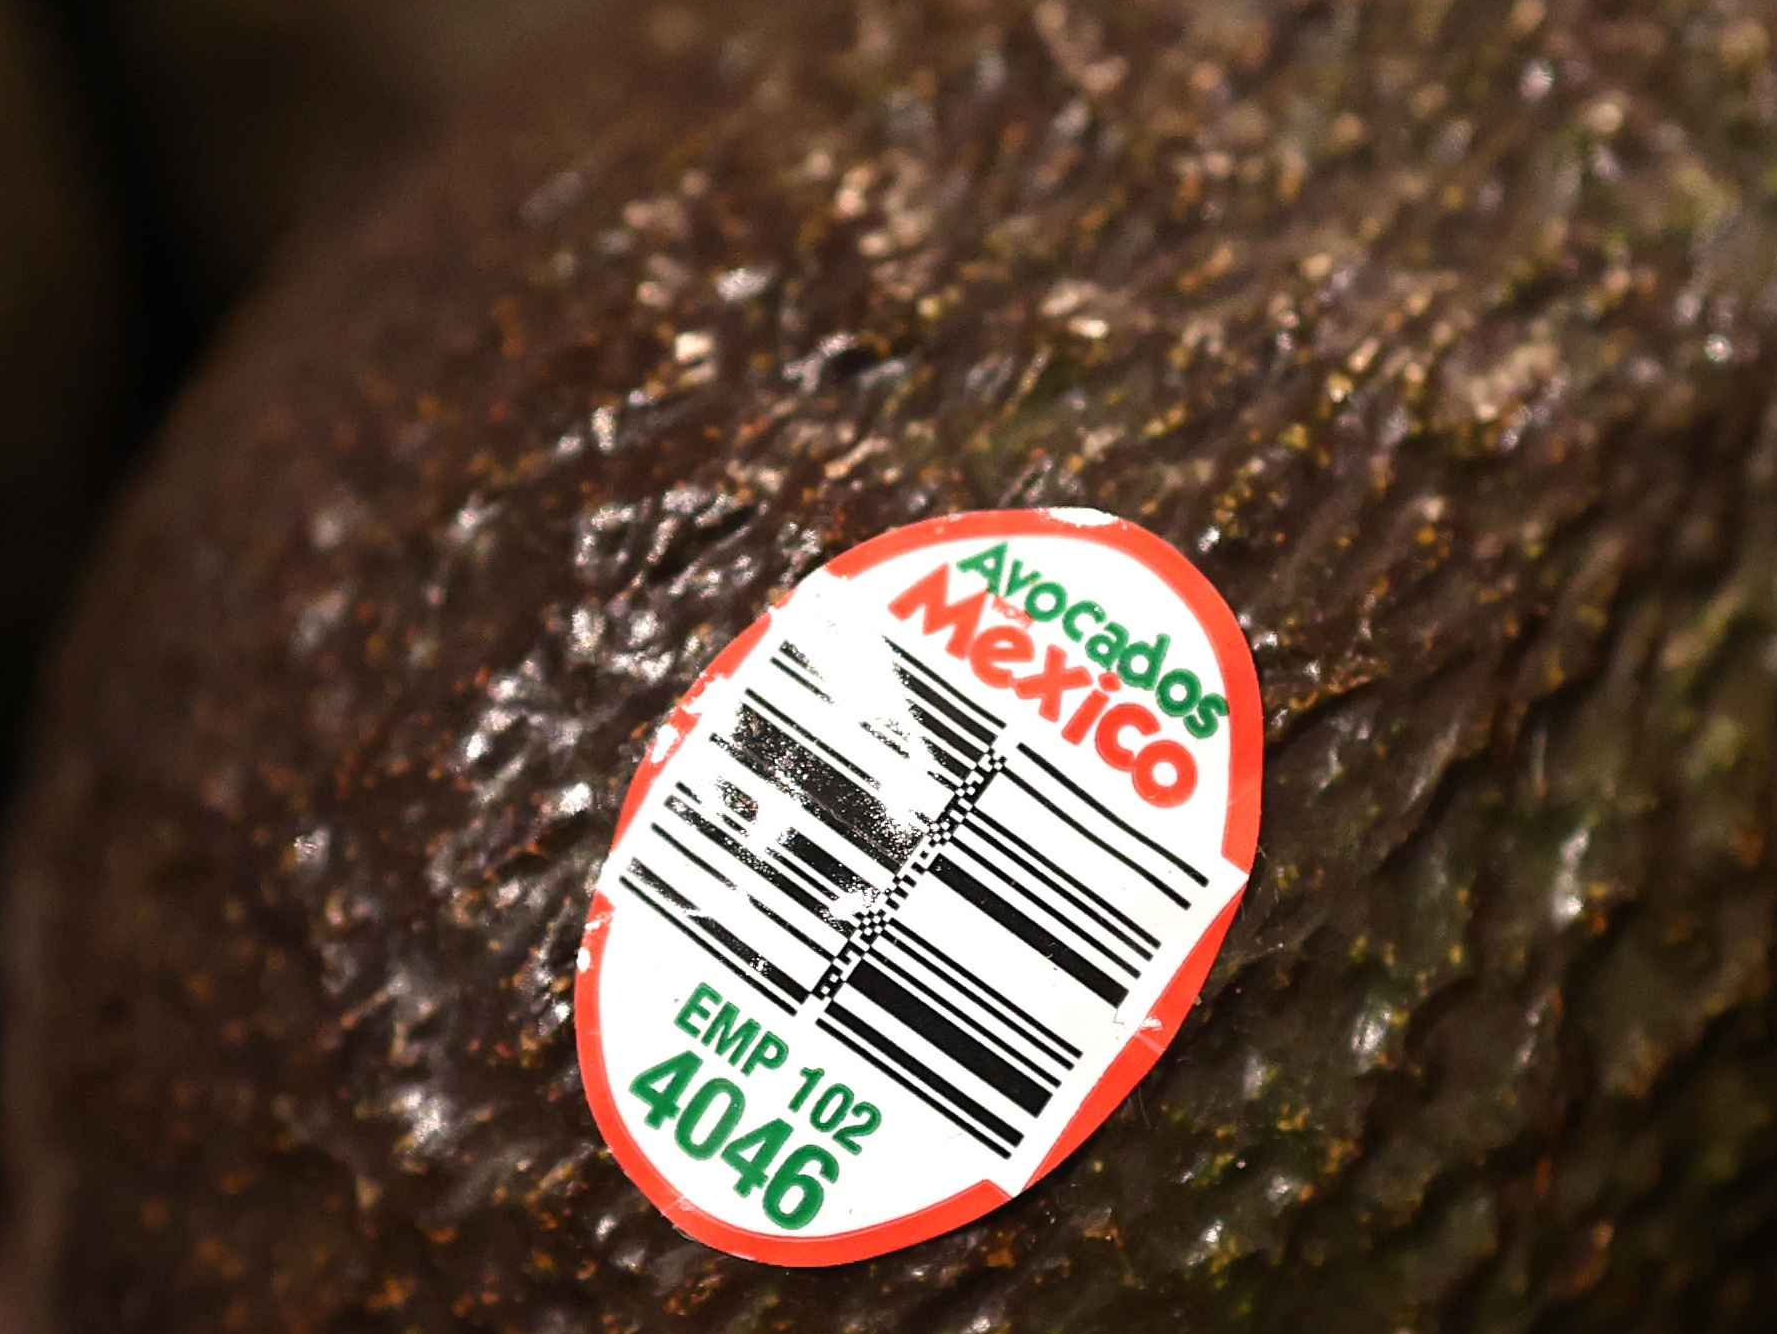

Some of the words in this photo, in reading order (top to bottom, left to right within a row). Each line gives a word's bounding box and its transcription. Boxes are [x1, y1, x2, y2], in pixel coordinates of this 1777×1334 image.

[887, 562, 1198, 808] Mexico
[955, 541, 1230, 740] Avocados
[628, 1050, 840, 1230] 4046
[674, 981, 789, 1077] EMP
[787, 1067, 882, 1156] 102
